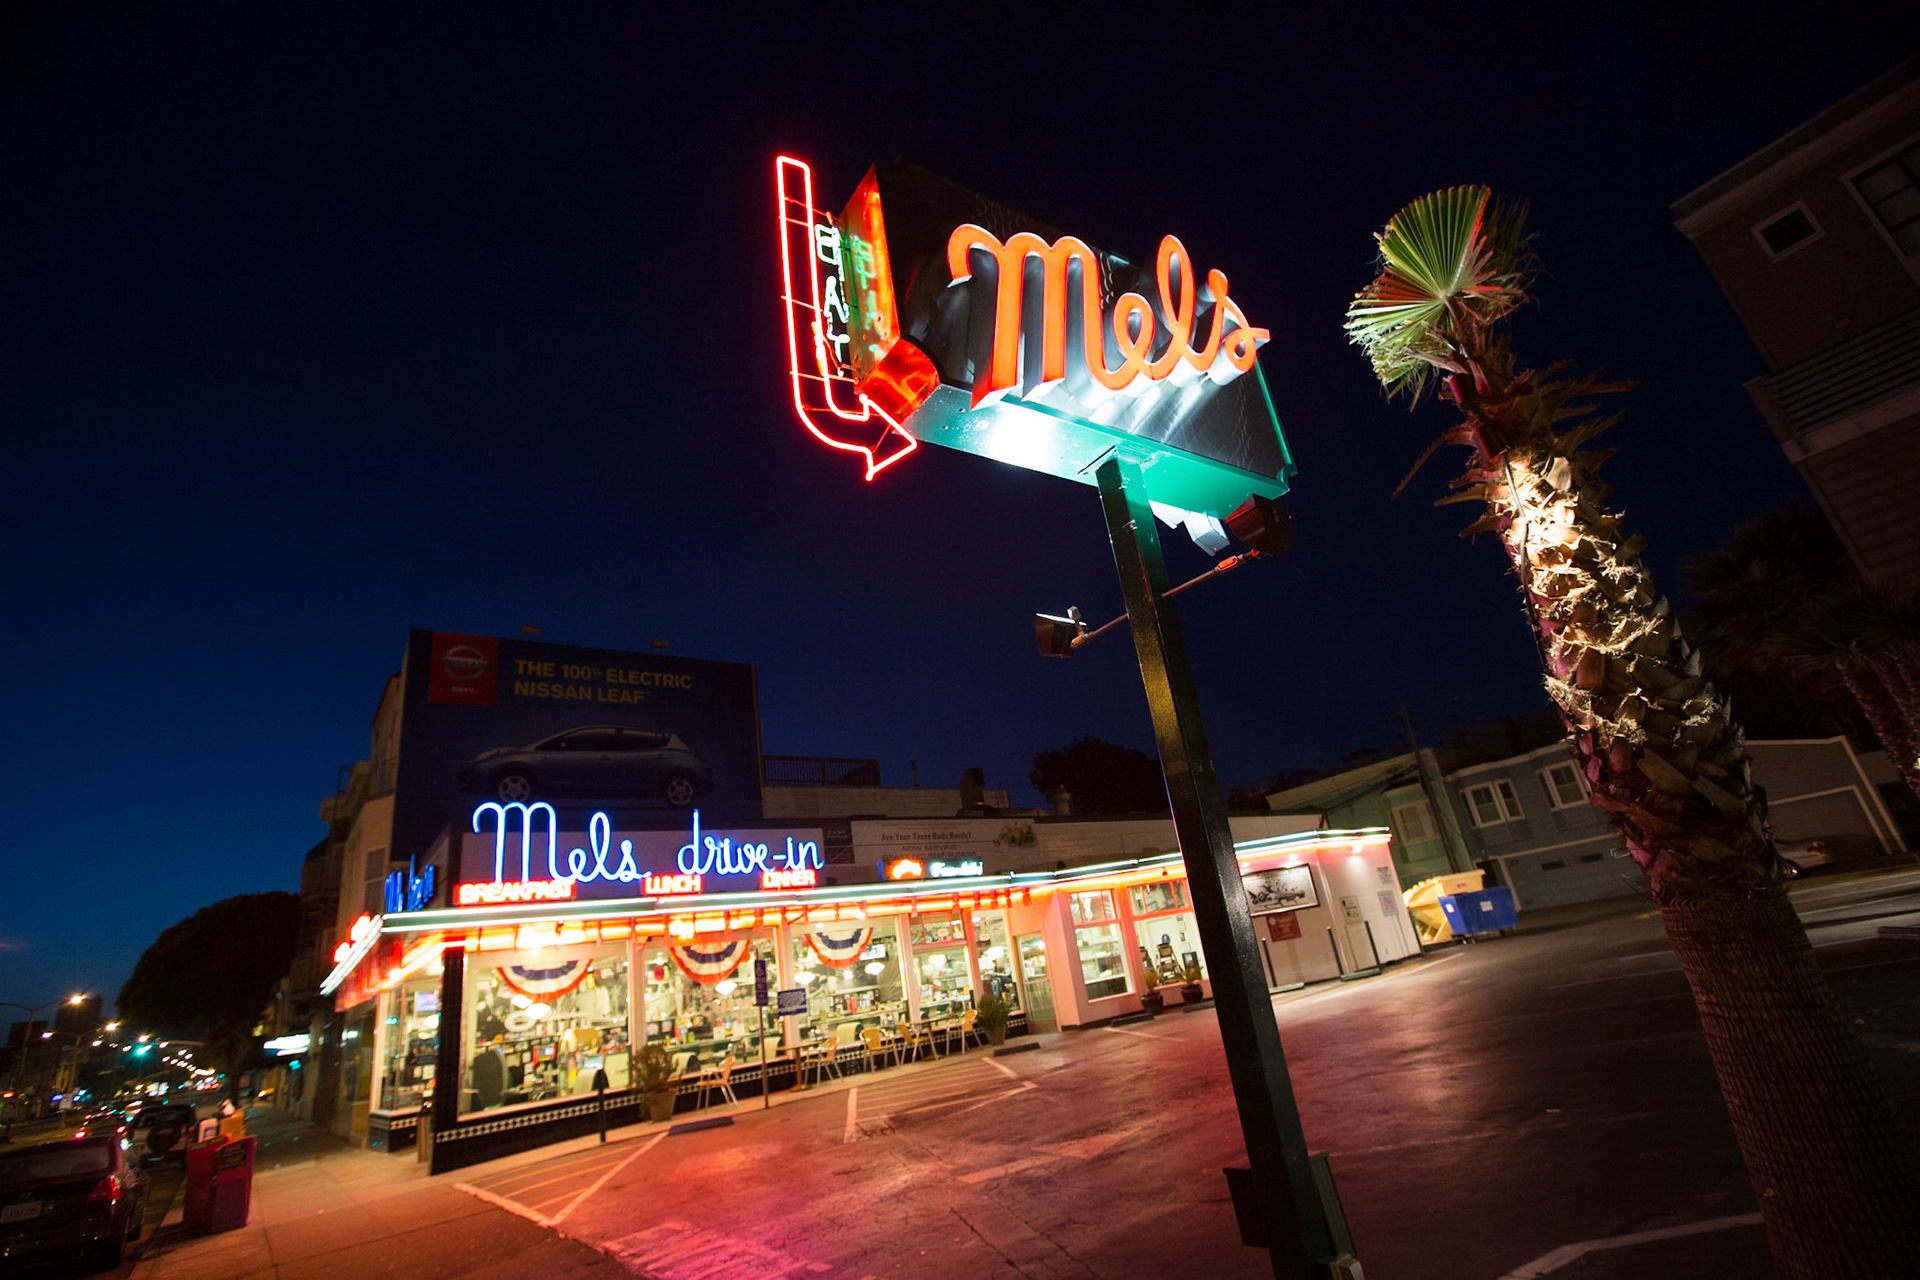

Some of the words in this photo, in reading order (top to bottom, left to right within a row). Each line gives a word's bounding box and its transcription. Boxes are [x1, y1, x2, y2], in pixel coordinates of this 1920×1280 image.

[947, 223, 1271, 404] Mels
[514, 659, 556, 678] THE
[605, 668, 693, 690] ELECTRIC
[513, 680, 593, 701] NISSAN
[596, 687, 646, 705] LEAF
[472, 801, 652, 883] Mels
[677, 808, 825, 876] drive-in
[881, 833, 893, 841] Are
[895, 832, 911, 841] Your
[644, 874, 702, 895] LUNCH
[762, 869, 816, 888] DINNER
[458, 880, 575, 905] BREAKFAST
